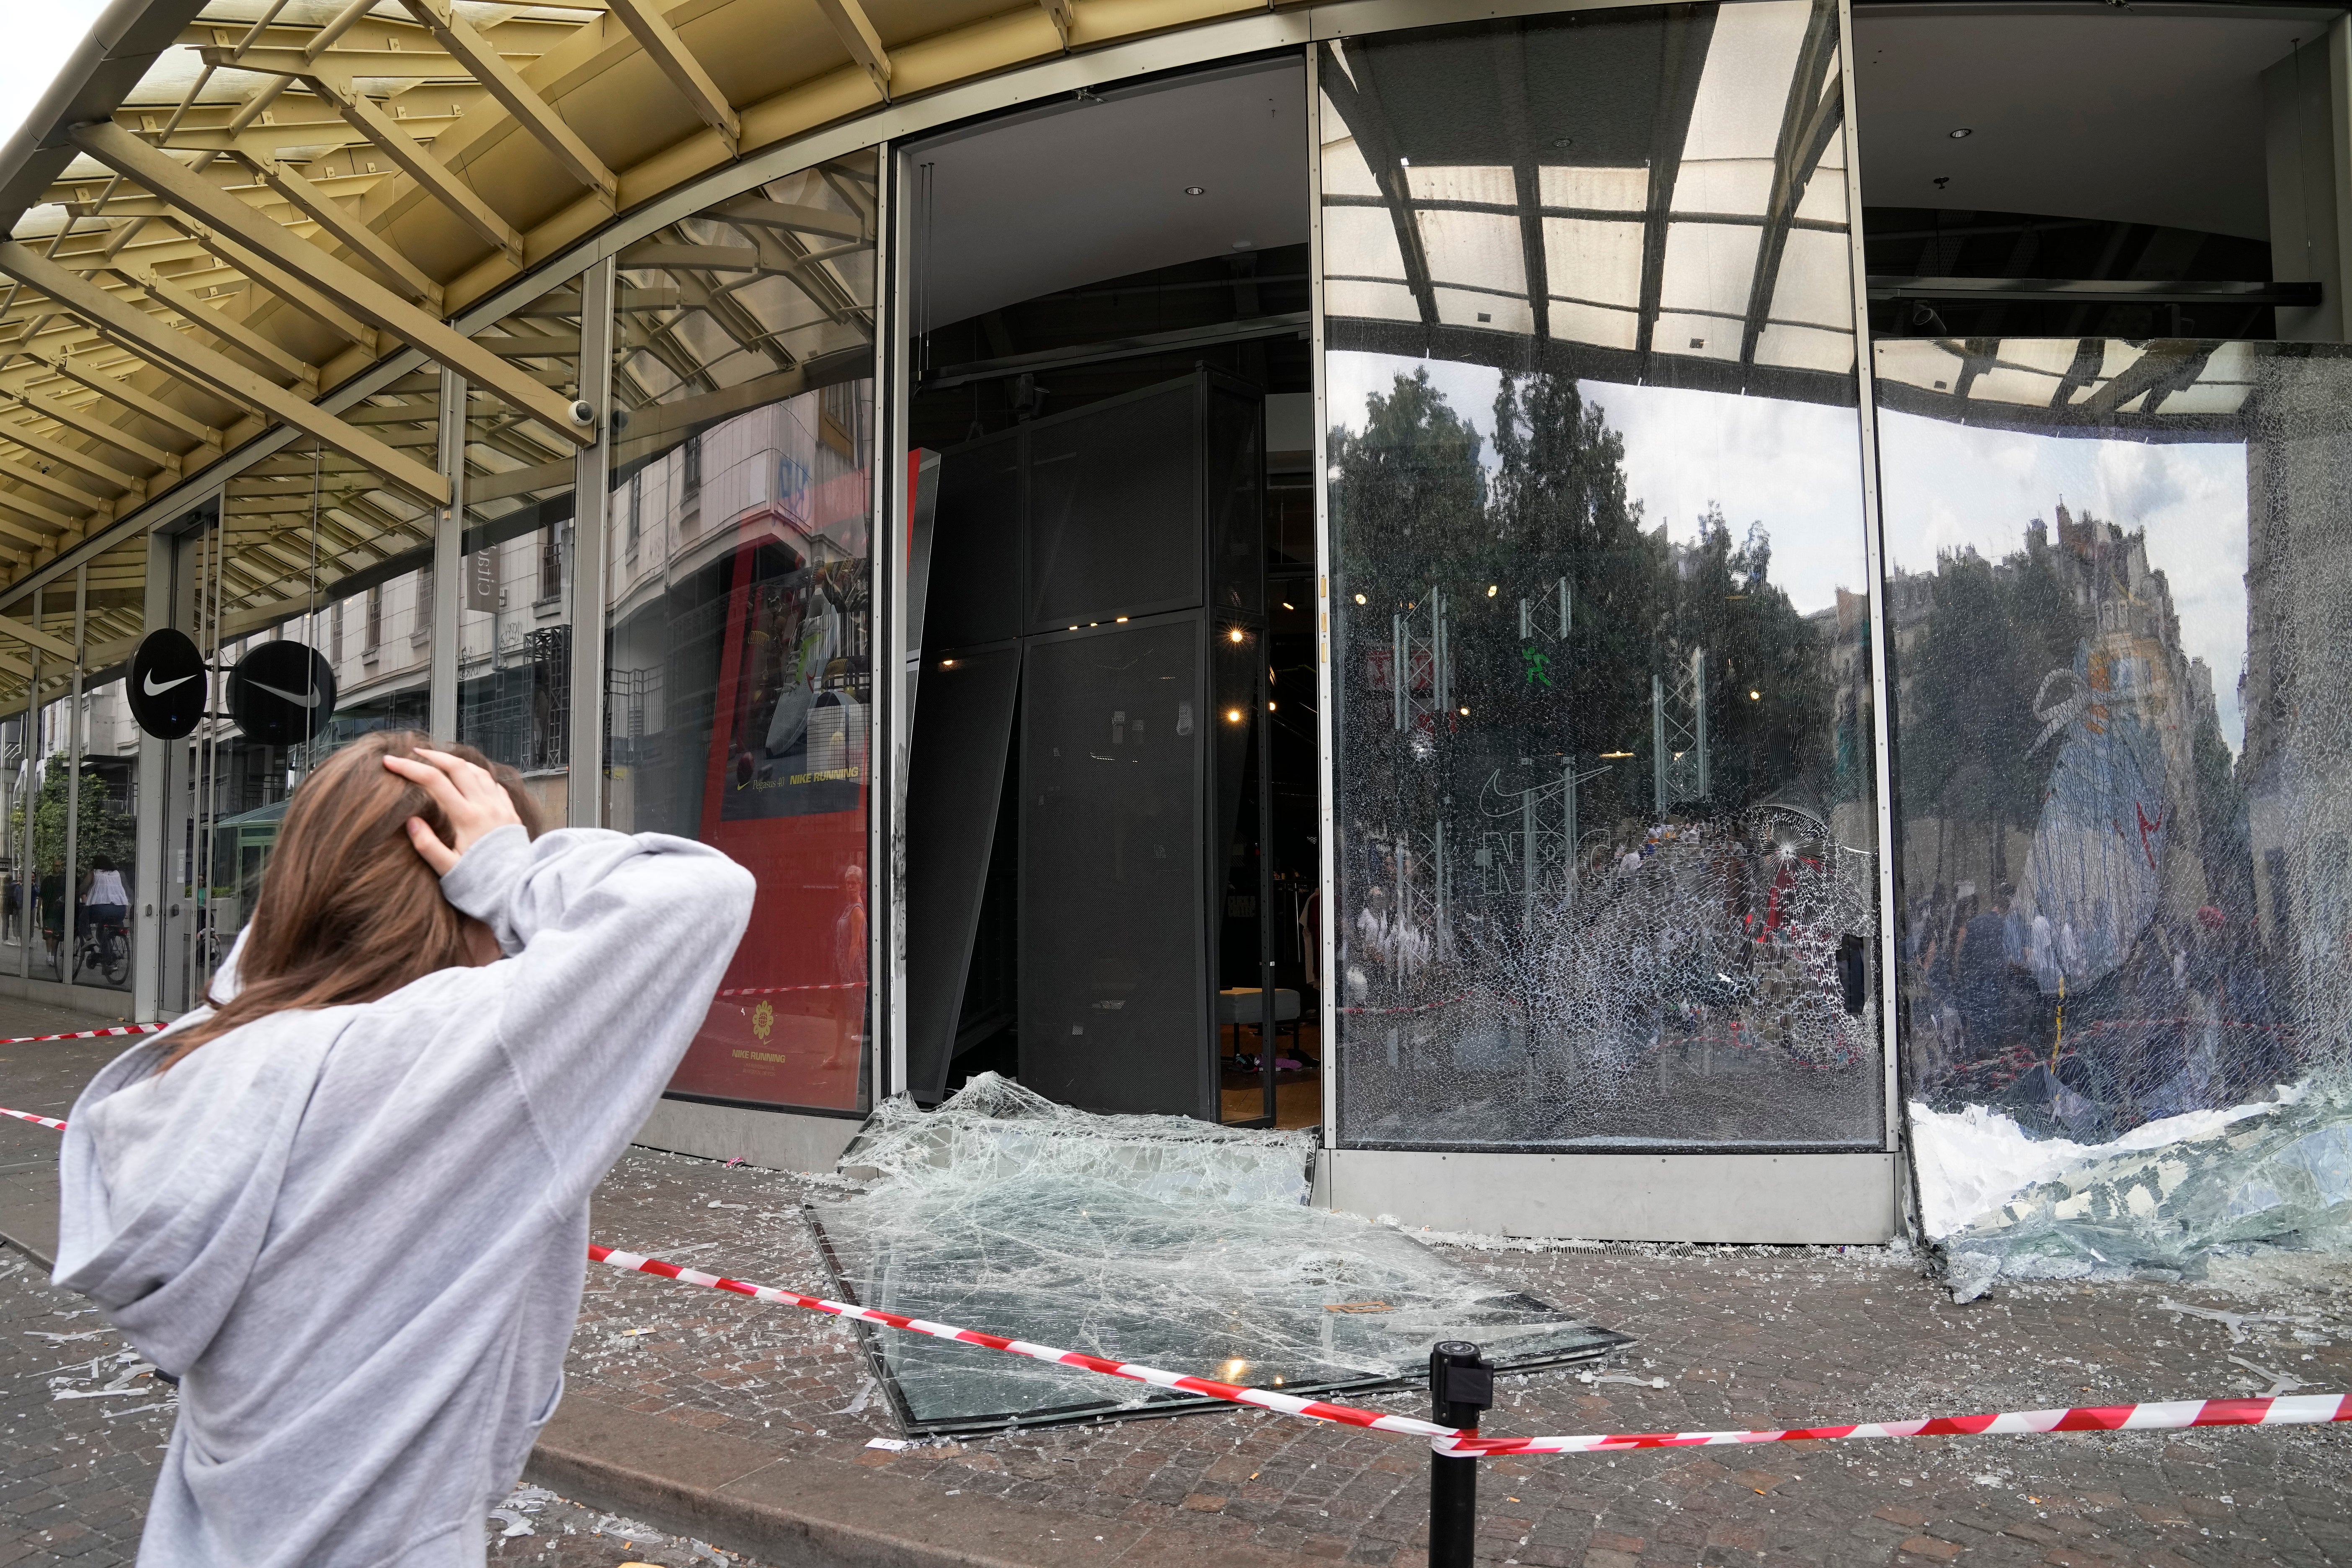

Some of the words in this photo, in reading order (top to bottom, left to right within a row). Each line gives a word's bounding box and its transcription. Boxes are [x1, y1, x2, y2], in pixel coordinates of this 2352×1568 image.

[790, 773, 812, 785] NIKE
[813, 767, 859, 782] RUNNING
[753, 780, 776, 792] Pegasus
[777, 777, 784, 787] 40
[1483, 829, 1612, 895] NRC
[732, 1049, 749, 1059] NIKE
[750, 1052, 786, 1063] RUNNING
